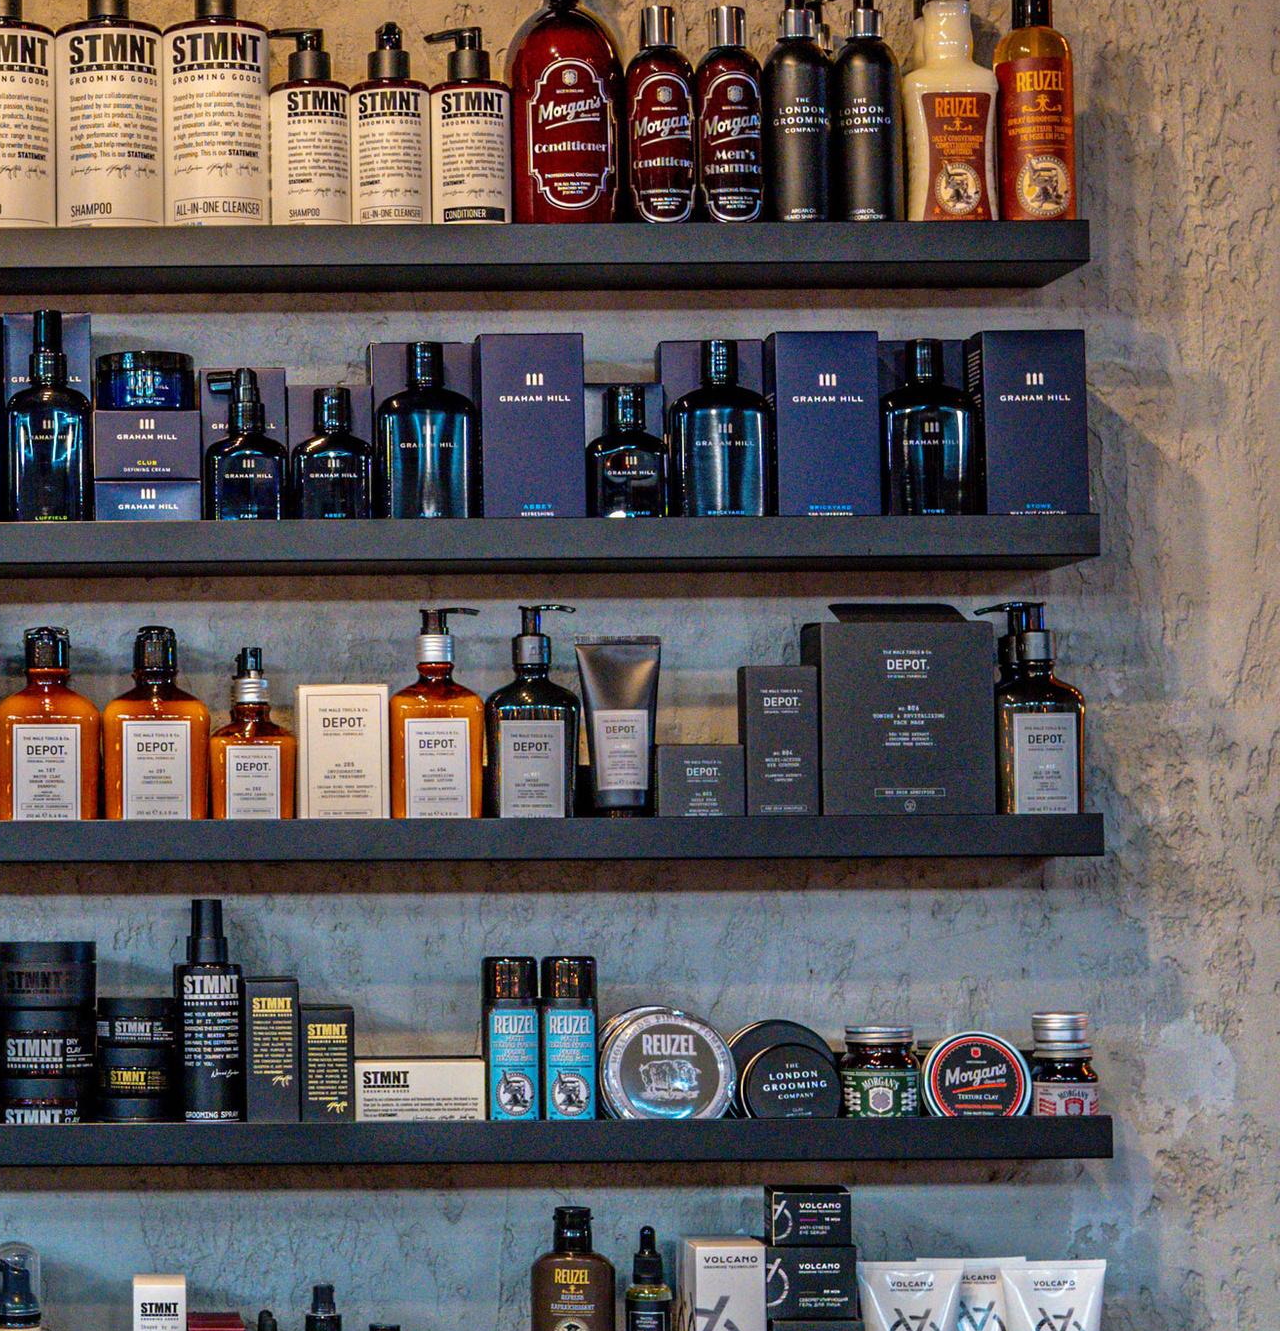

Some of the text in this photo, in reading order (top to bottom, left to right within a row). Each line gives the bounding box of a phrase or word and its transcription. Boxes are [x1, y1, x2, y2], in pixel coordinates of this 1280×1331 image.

[70, 34, 157, 66] STMNT
[172, 33, 260, 65] STMNT
[1016, 71, 1065, 93] REUZEL
[287, 91, 347, 111] STMNT
[359, 91, 420, 113] STMNT
[441, 93, 503, 114] STMNT
[935, 97, 979, 118] REUZEL
[538, 95, 601, 123] Morgan's
[779, 105, 824, 115] LONDON
[773, 116, 830, 127] GROOMING
[715, 149, 756, 160] Men's
[71, 202, 112, 217] SHAMPOO
[176, 201, 260, 216] ALL-IN-ONE CLEANSER
[289, 208, 320, 218] SHAMPOO
[362, 208, 421, 219] ALL-IN-ONE CLEANSER
[445, 209, 486, 220] CONDITIONER
[1000, 394, 1043, 402] GRAHAM
[183, 975, 238, 994] STMNT
[252, 997, 292, 1010] STMNT
[115, 1021, 152, 1033] STMNT
[307, 1023, 348, 1036] STMNT
[494, 1015, 535, 1034] REUZEL
[549, 1015, 592, 1035] REUZEL
[7, 1039, 63, 1057] STMNT
[642, 1034, 697, 1056] REUZEL
[110, 1071, 146, 1082] STMNT
[363, 1071, 409, 1084] STMNT
[769, 1070, 818, 1081] LONDON
[944, 1064, 1007, 1087] Morgan's
[763, 1080, 827, 1092] GROOMING
[778, 1092, 814, 1100] COMPANY
[799, 1202, 841, 1210] VOLCANO
[704, 1256, 758, 1264] VOLCANO
[554, 1268, 590, 1284] REUZEL
[890, 1280, 934, 1289] VOLCANO
[1033, 1280, 1075, 1288] VOLCANO
[140, 1302, 178, 1314] STMNT
